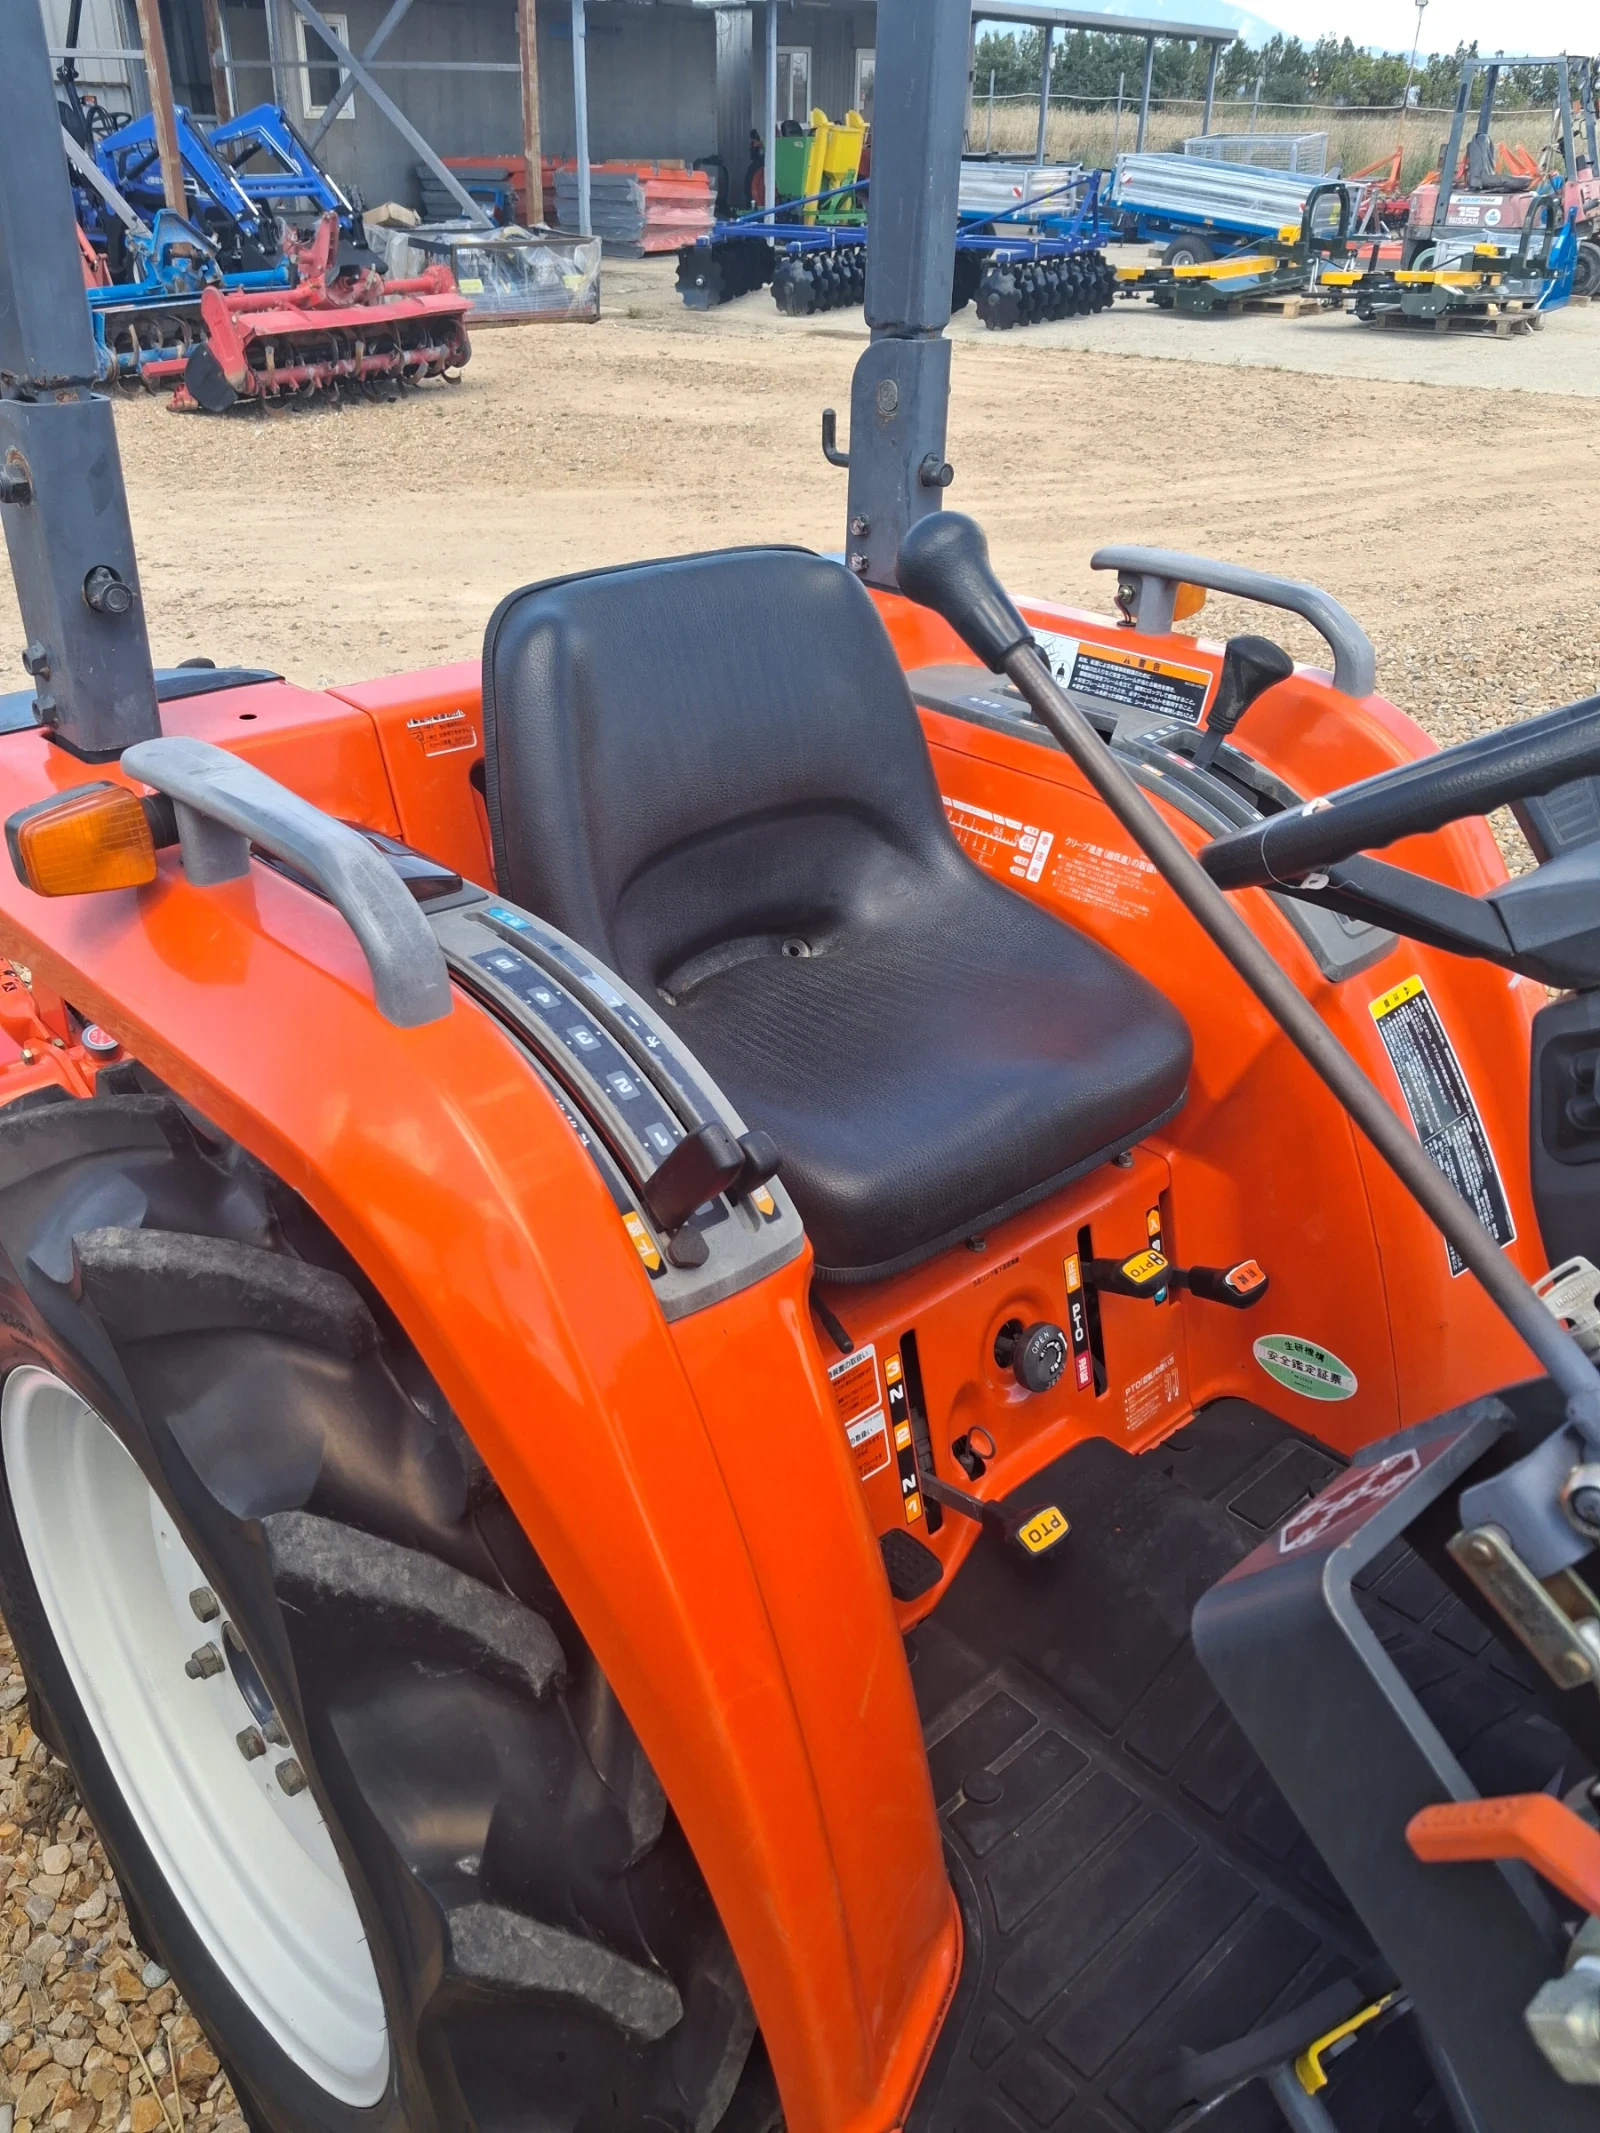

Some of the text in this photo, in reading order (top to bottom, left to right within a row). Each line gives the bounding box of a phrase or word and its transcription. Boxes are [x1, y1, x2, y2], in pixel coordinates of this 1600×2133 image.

[1448, 217, 1479, 225] NISSAN
[1457, 206, 1480, 217] 15
[495, 959, 514, 970] 5
[536, 992, 550, 1003] 4
[575, 1031, 594, 1045] 3
[614, 1077, 633, 1093] 2
[654, 1131, 668, 1147] 1
[1066, 1259, 1078, 1287] 正転
[1130, 1260, 1154, 1278] PTO
[1072, 1302, 1083, 1342] PTO
[1031, 1329, 1050, 1354] OPEN
[1284, 1341, 1324, 1362] 生研機構
[887, 1359, 901, 1378] 3
[1267, 1350, 1342, 1386] 安全鑑定証票
[889, 1384, 904, 1404] N
[896, 1426, 911, 1445] 2
[902, 1474, 917, 1493] N
[908, 1499, 918, 1513] 1
[1027, 1513, 1062, 1544] PTO
